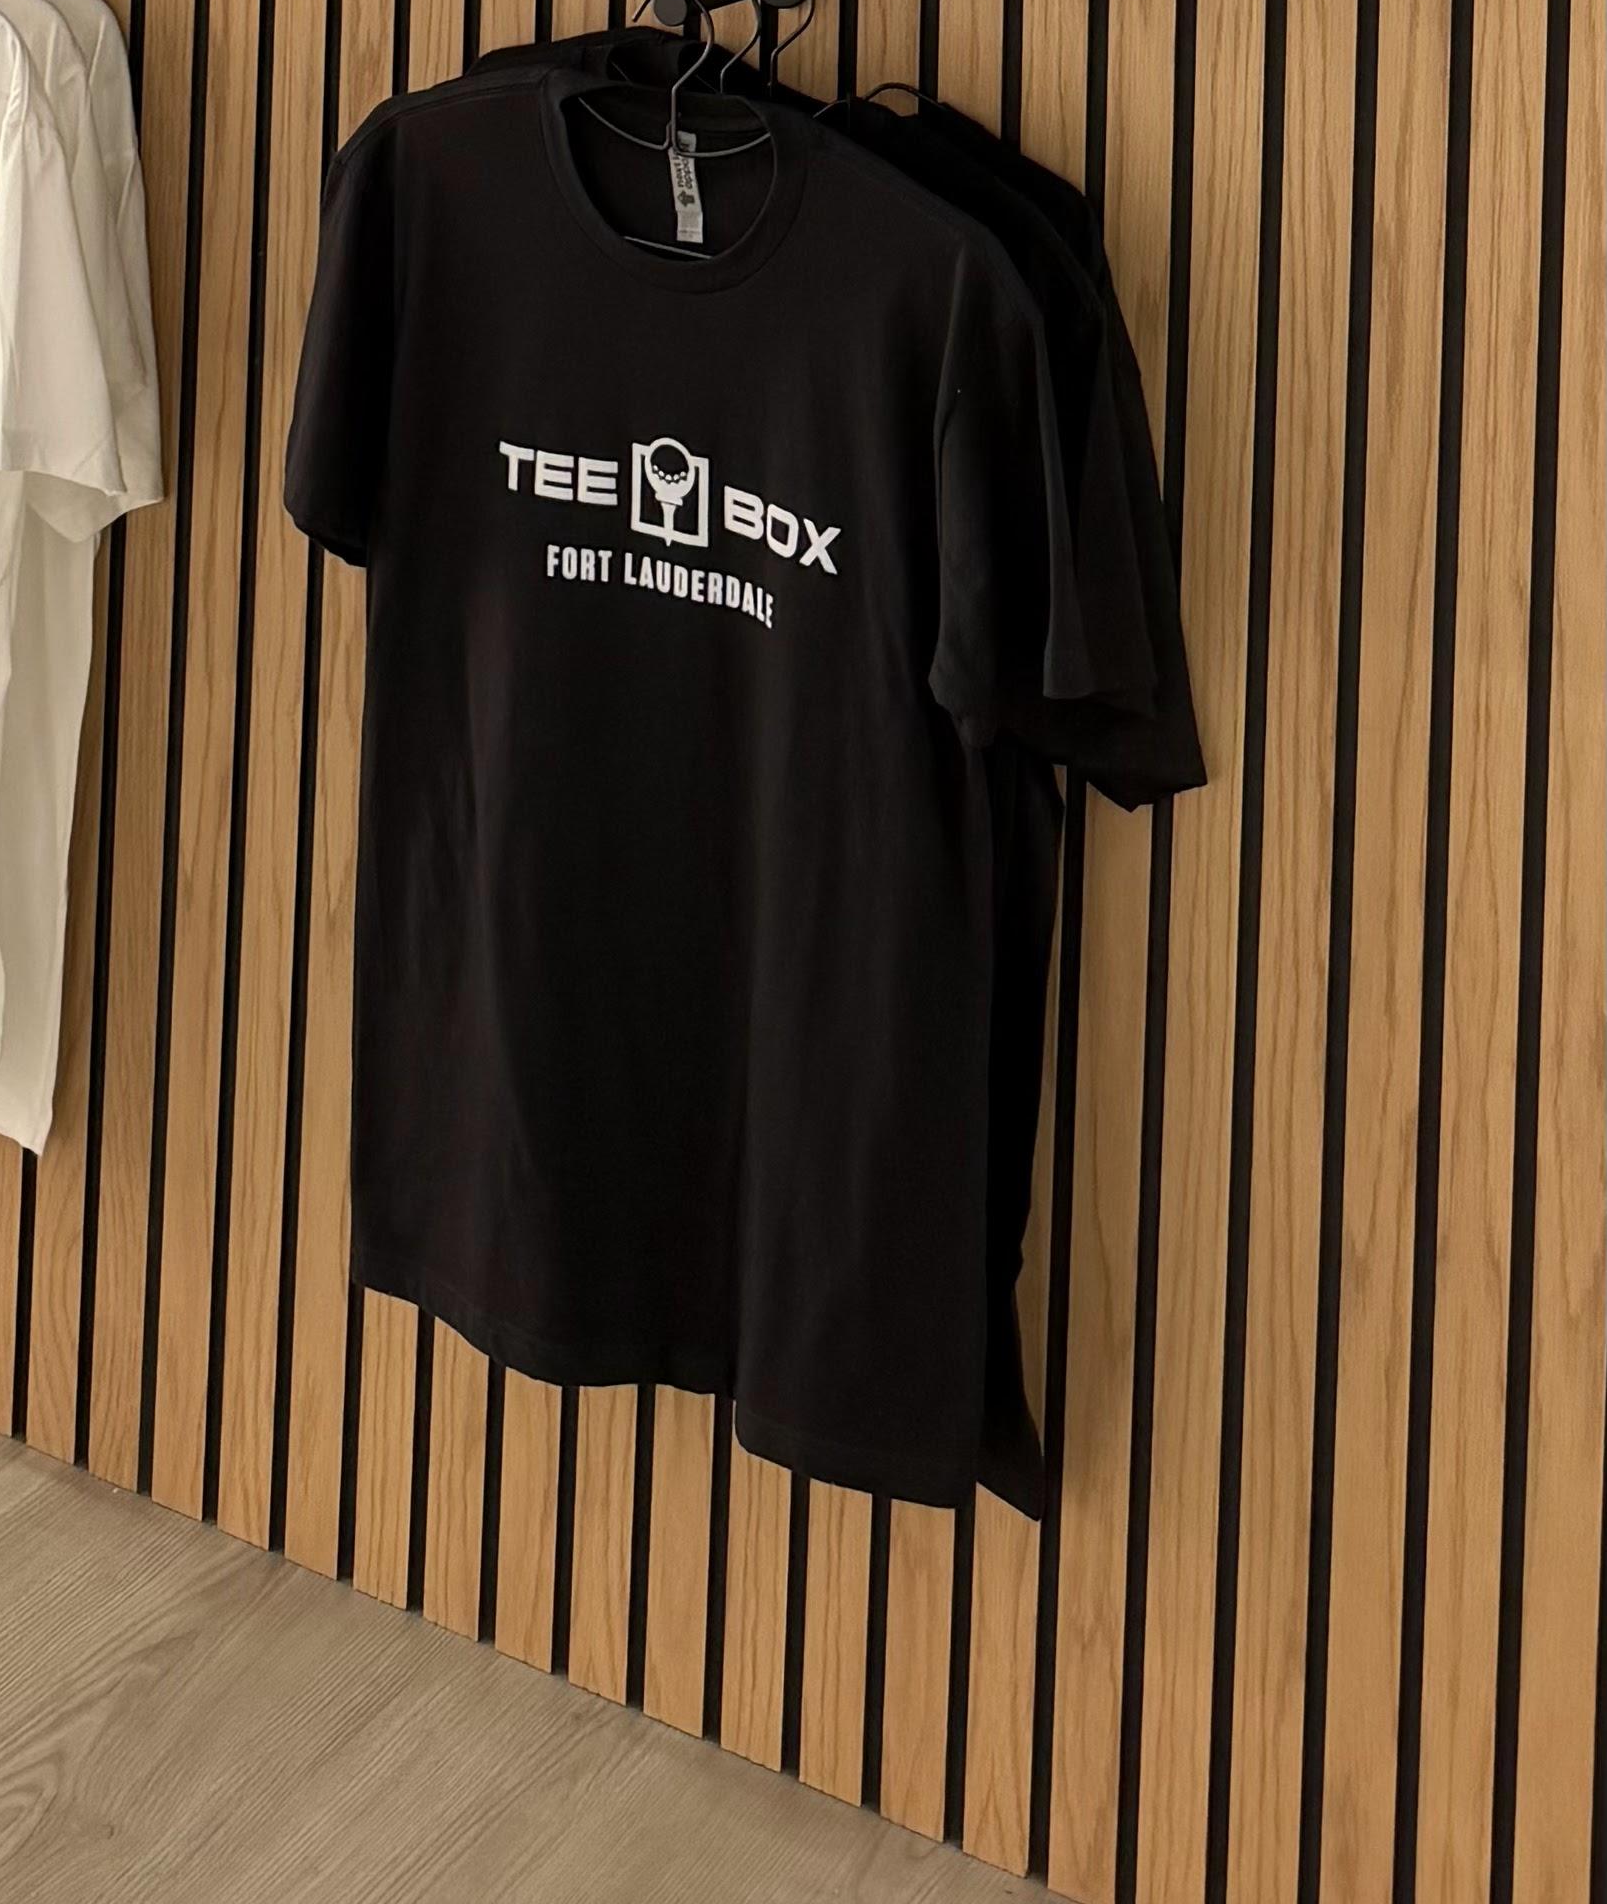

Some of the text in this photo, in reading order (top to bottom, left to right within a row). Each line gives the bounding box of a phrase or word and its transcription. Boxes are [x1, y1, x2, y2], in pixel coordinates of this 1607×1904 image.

[498, 440, 842, 576] TEE BOX
[546, 544, 775, 630] FORT LAUDERDALE
